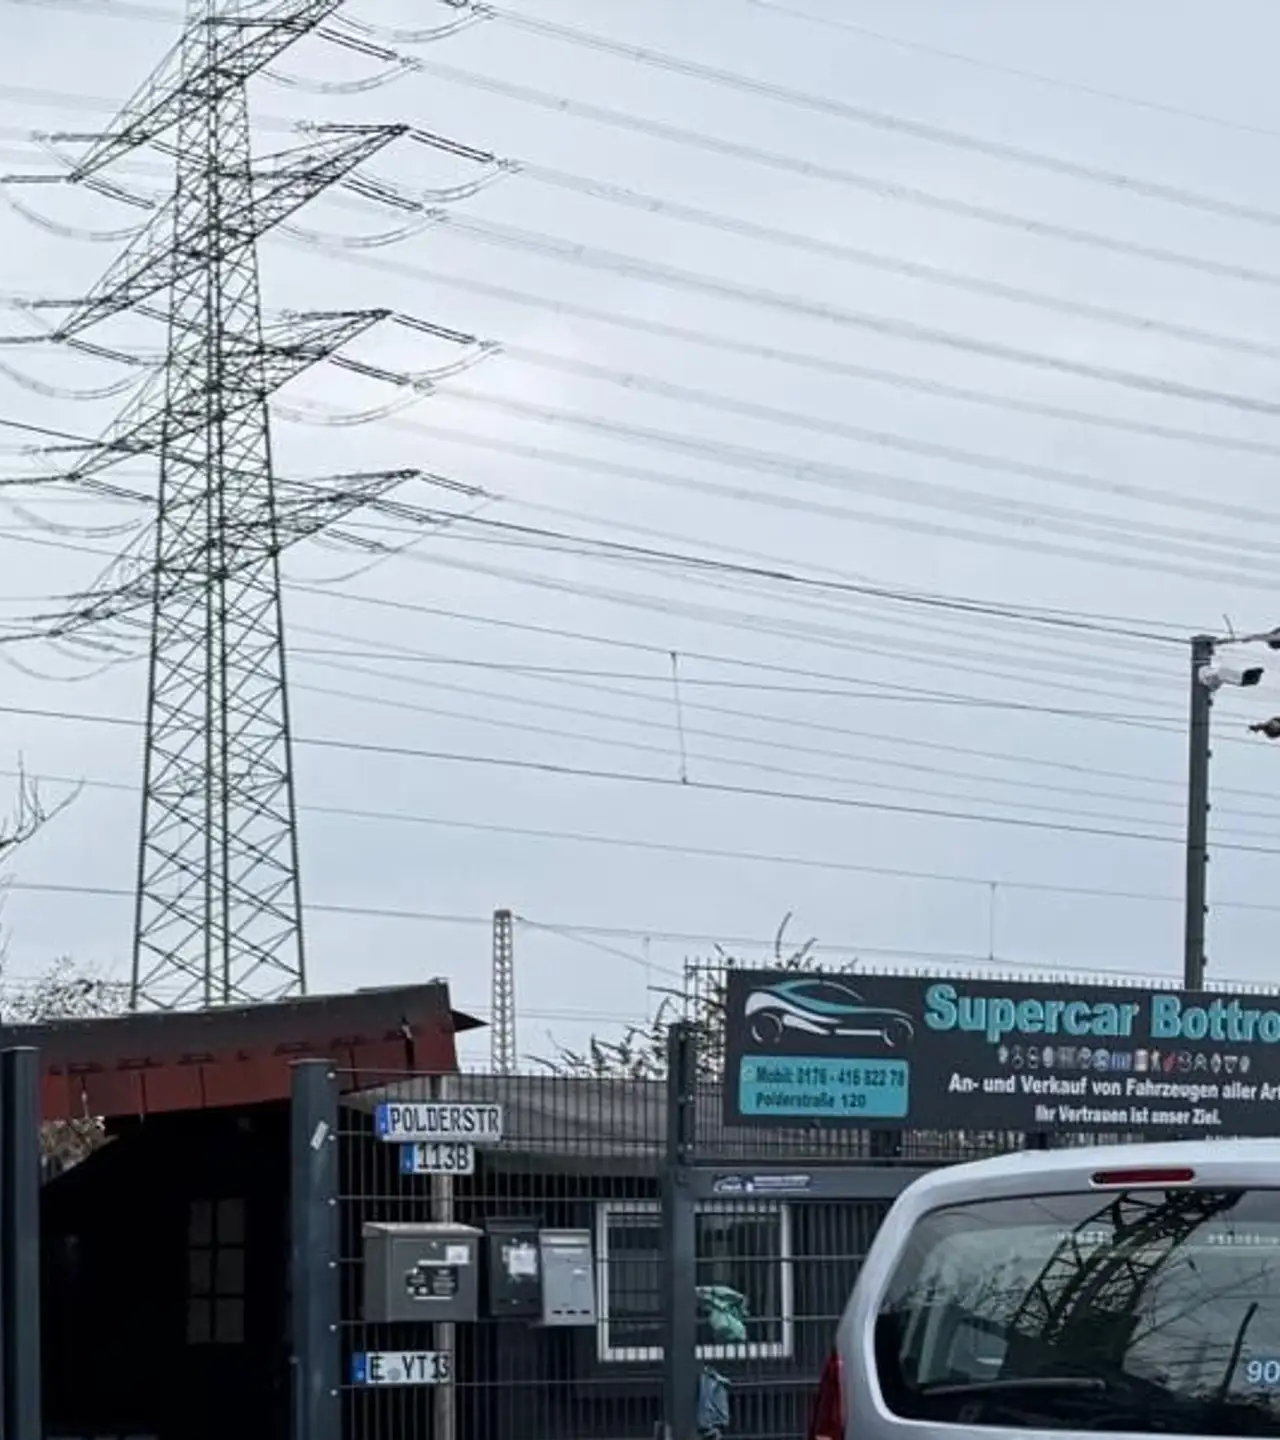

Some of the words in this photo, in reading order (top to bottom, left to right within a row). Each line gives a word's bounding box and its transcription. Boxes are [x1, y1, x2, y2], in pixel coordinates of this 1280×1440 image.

[924, 983, 1139, 1043] Supercar
[948, 1073, 979, 1093] An-
[982, 1074, 1015, 1094] und
[1020, 1075, 1087, 1095] Verkauf
[1092, 1080, 1121, 1096] von
[1126, 1078, 1219, 1102] Fahrzeugen
[1222, 1081, 1257, 1100] aller
[392, 1107, 499, 1132] POLDERSTR
[1035, 1104, 1057, 1122] Ihr
[1059, 1106, 1127, 1123] Vertrauen
[1130, 1107, 1149, 1123] ist
[1151, 1108, 1189, 1124] unser
[418, 1143, 469, 1170] 113B
